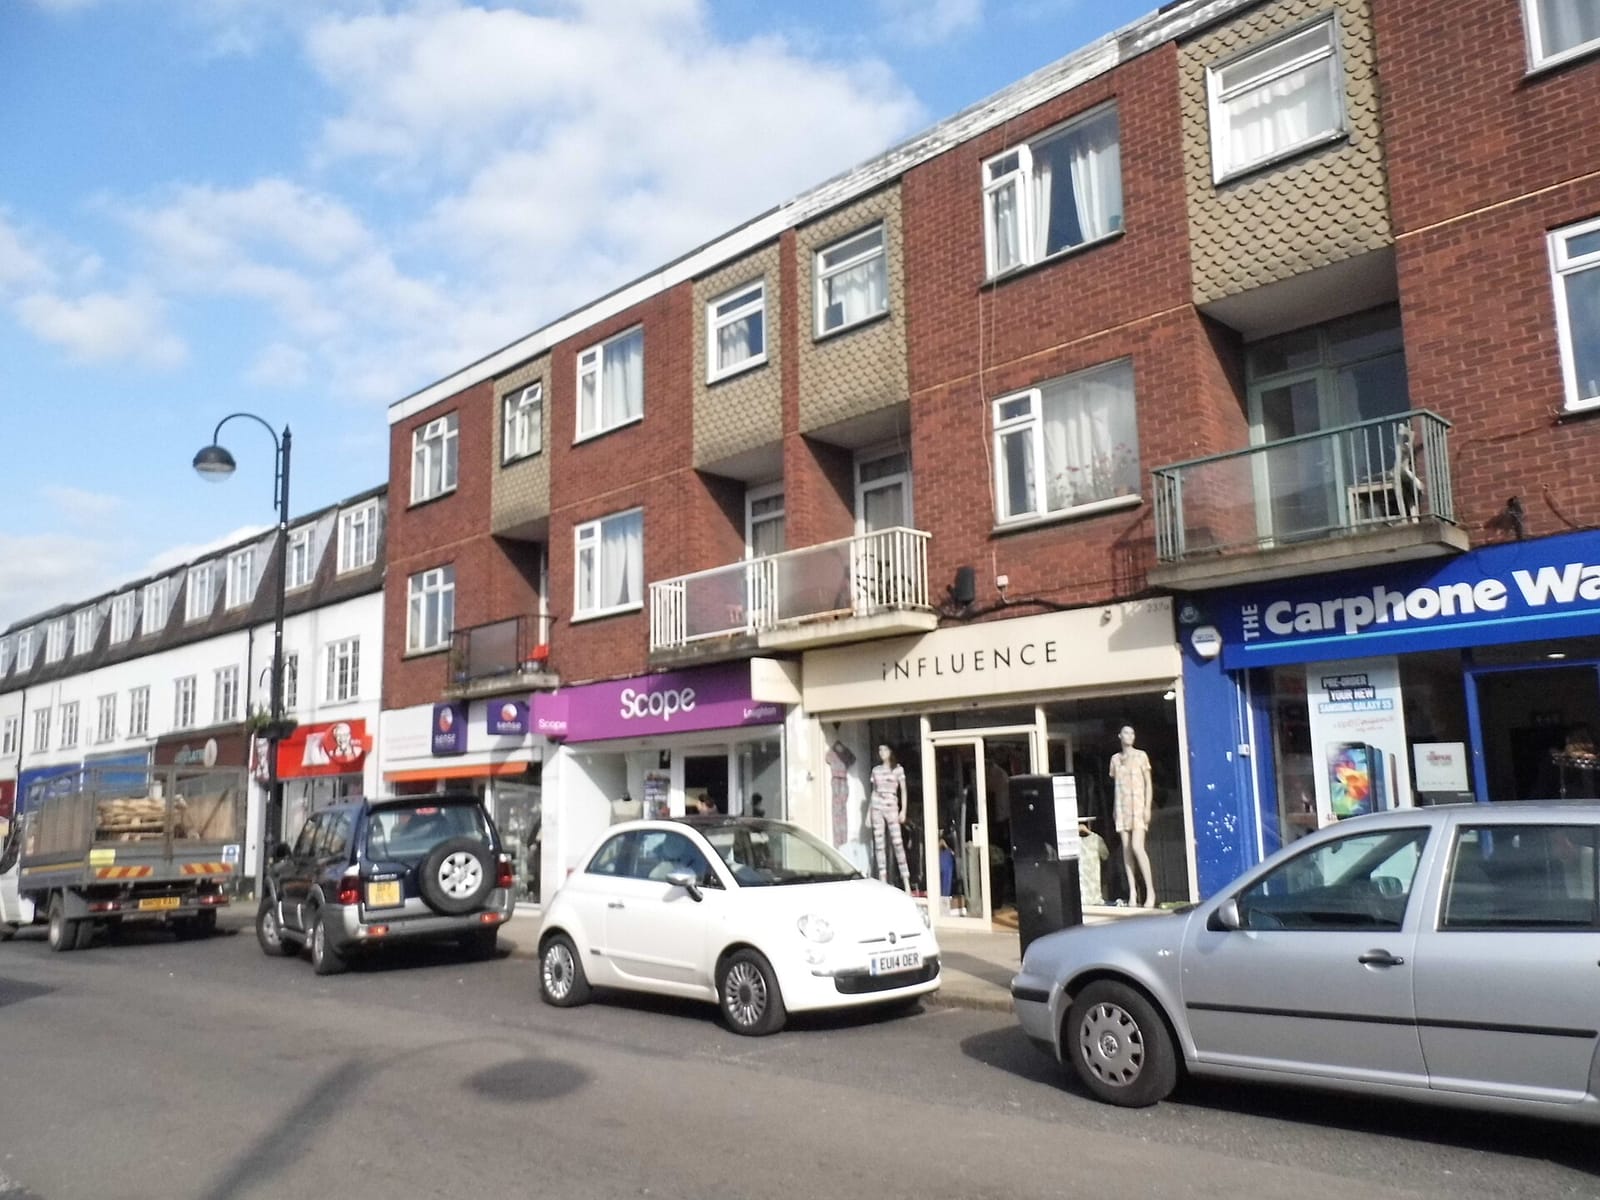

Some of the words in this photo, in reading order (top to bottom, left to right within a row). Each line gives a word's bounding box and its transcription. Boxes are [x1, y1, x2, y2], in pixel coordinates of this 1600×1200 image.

[1264, 577, 1509, 636] Carphone
[1242, 604, 1260, 642] THE
[620, 688, 696, 722] Scope
[1331, 689, 1353, 701] YOUR
[1354, 687, 1374, 699] NEW
[1354, 700, 1381, 711] GALAXY
[538, 718, 568, 730] Scope
